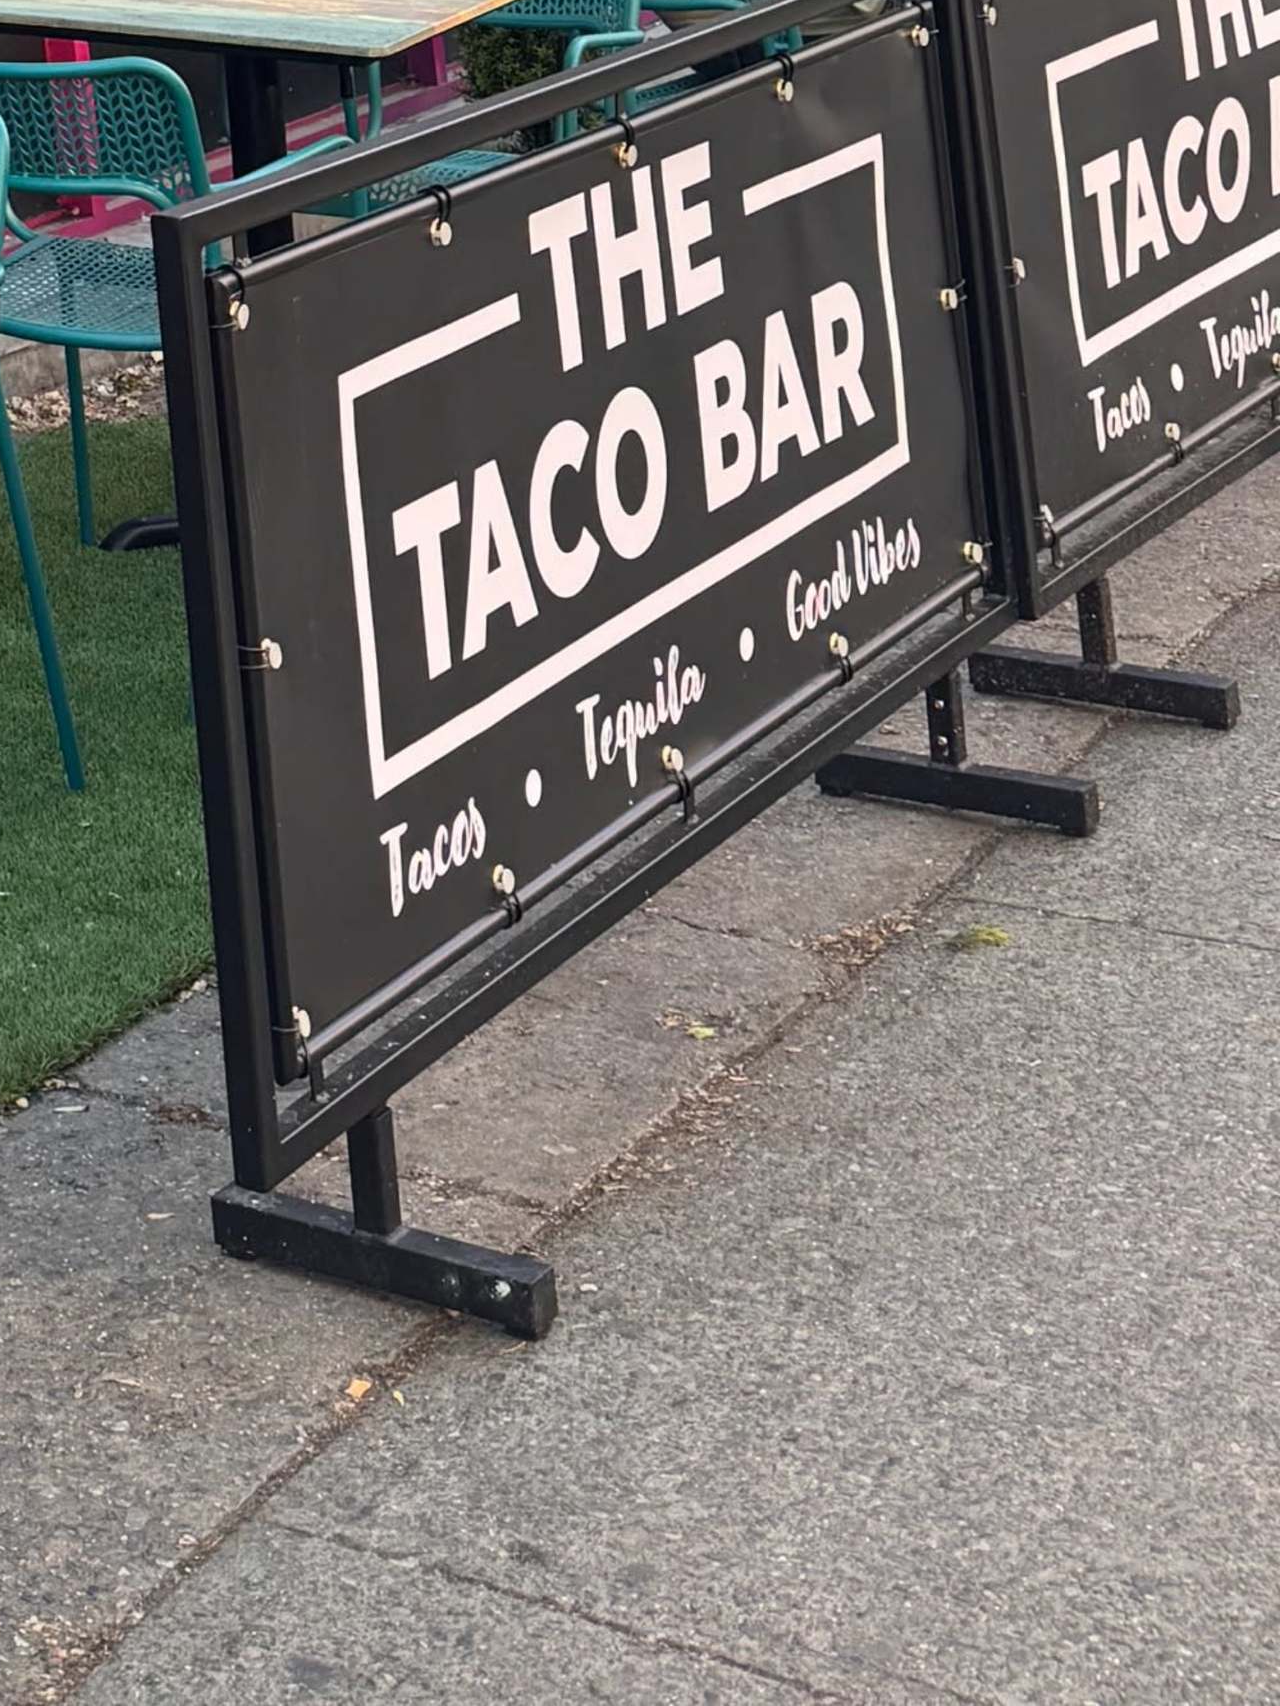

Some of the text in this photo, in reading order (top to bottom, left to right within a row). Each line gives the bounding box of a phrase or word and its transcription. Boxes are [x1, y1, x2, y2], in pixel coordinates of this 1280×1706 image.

[527, 139, 726, 373] THE
[1081, 96, 1251, 290] TACO
[391, 280, 876, 681] TACO BAR
[1087, 288, 1280, 453] Tacos Tequila
[380, 516, 921, 918] Tacos Tequila Good Vibes
